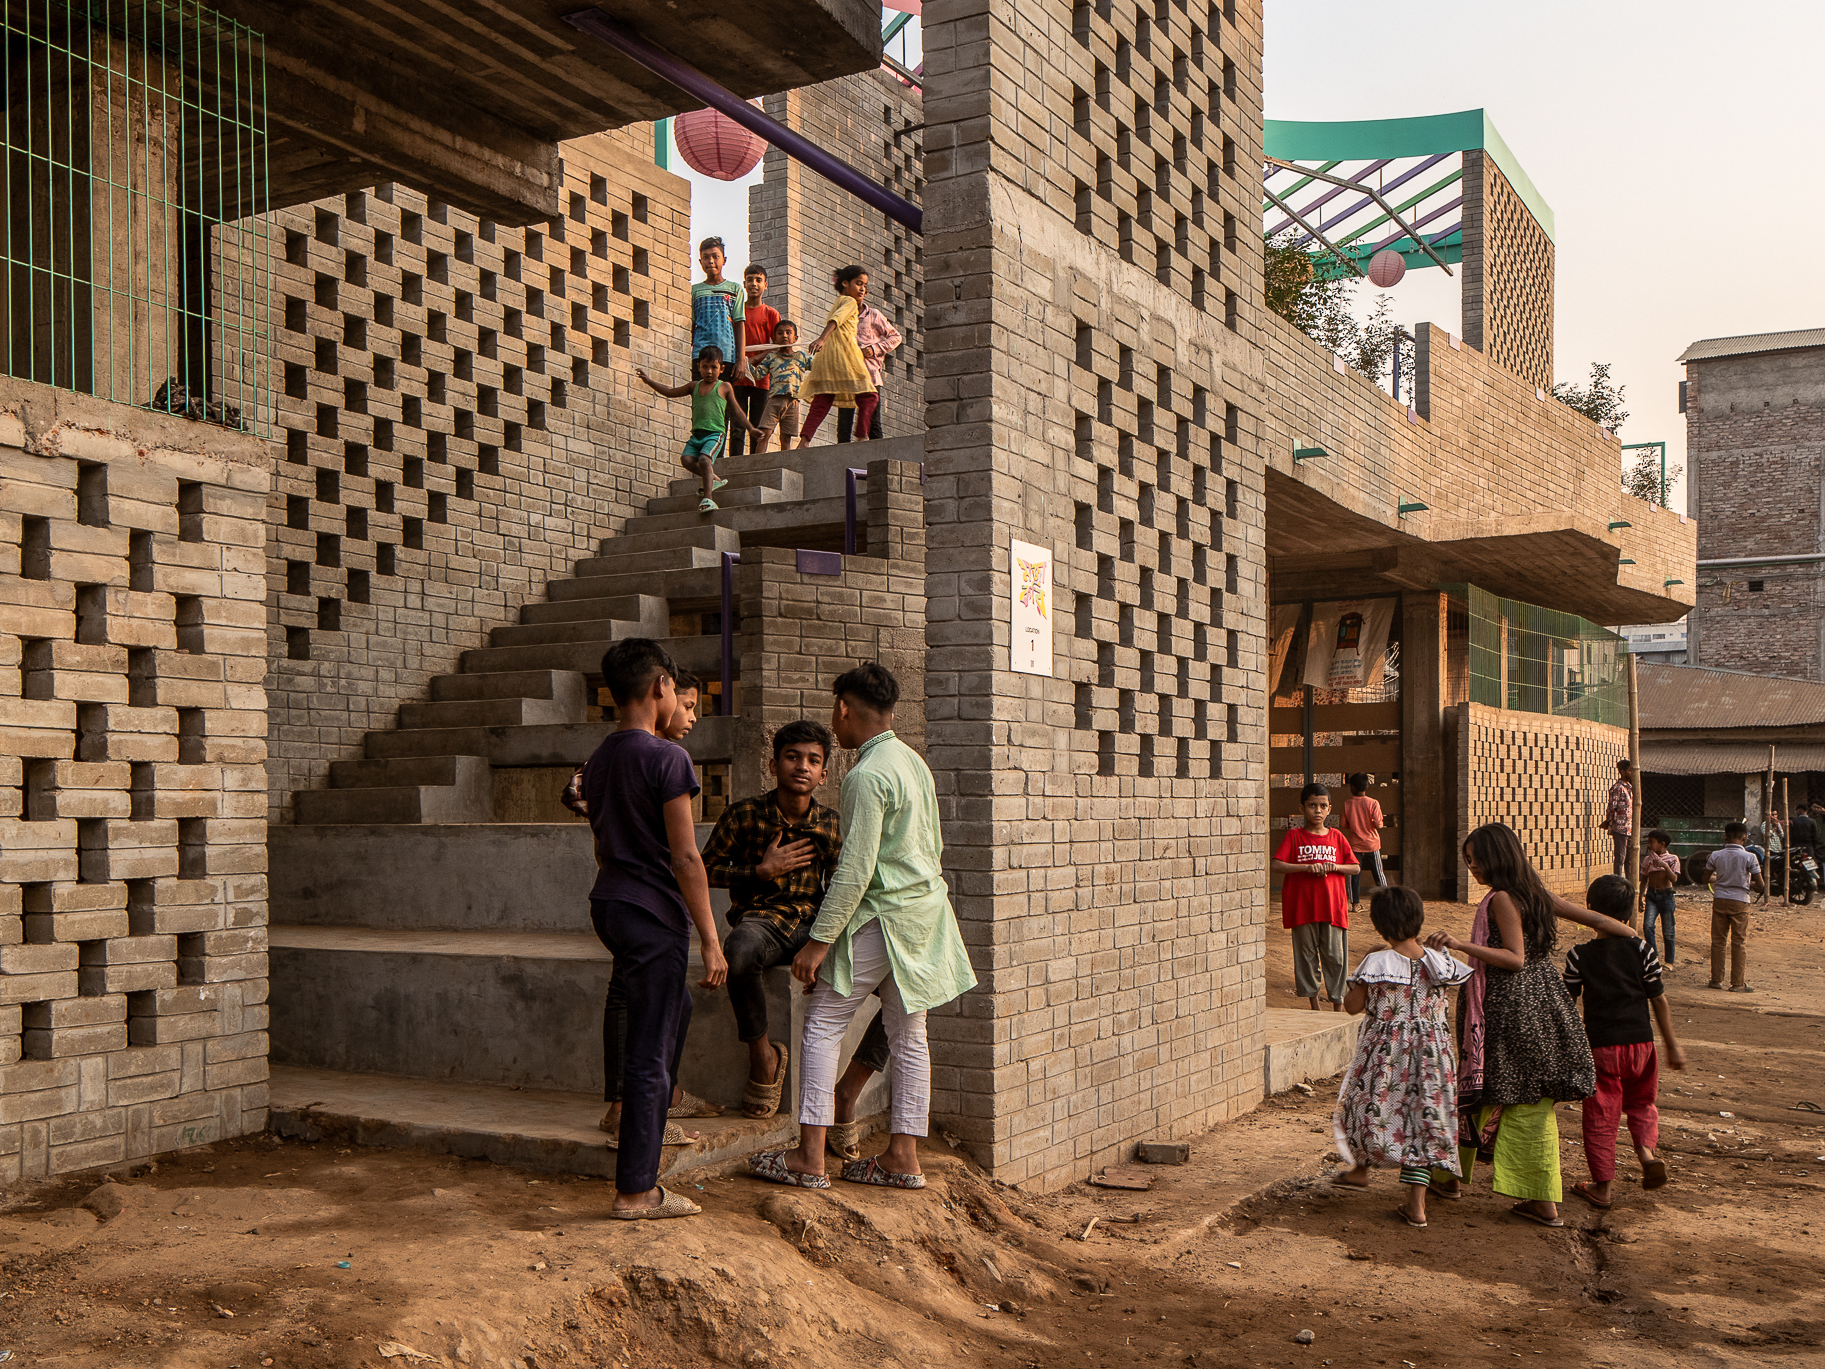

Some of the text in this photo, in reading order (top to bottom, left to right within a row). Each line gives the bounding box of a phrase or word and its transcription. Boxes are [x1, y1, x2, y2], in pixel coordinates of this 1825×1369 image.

[1025, 626, 1040, 635] LOCATION
[1030, 639, 1035, 652] 1
[1299, 845, 1336, 855] TOMMY
[1313, 853, 1336, 862] JEANS
